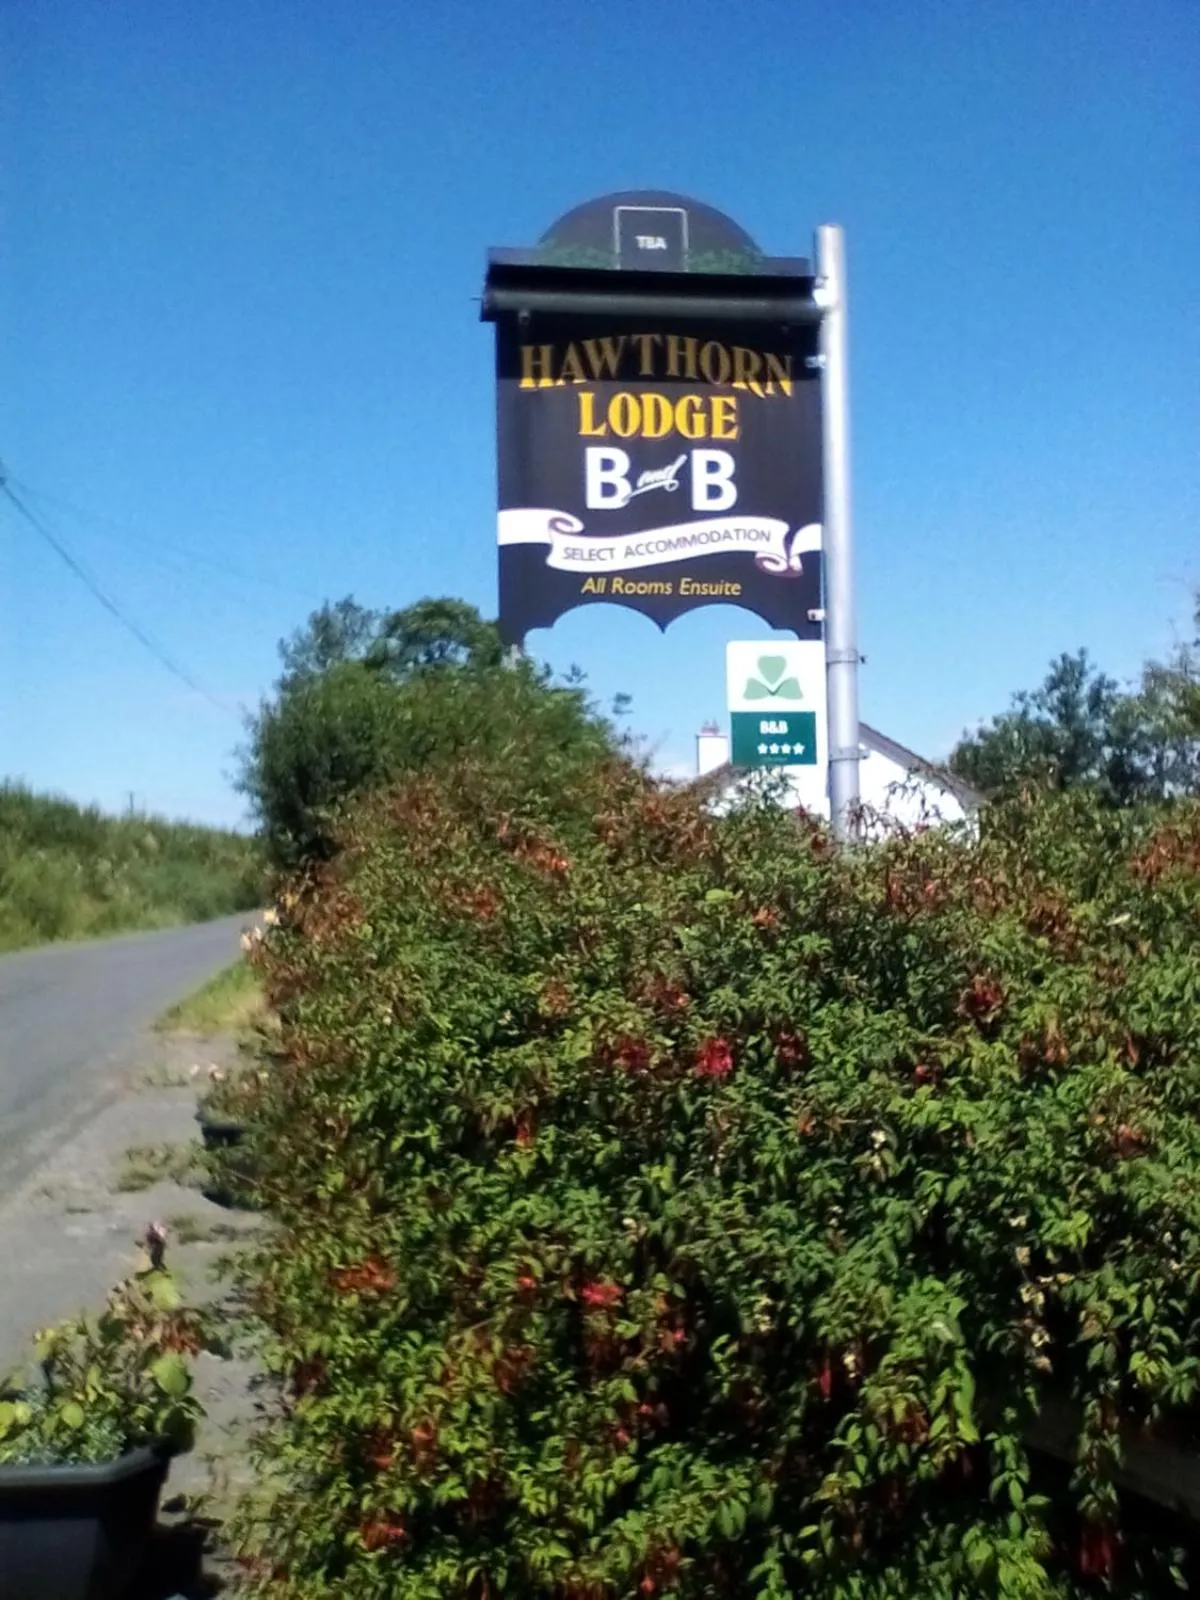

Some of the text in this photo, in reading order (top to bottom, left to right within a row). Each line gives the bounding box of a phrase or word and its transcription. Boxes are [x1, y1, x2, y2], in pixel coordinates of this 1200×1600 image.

[518, 334, 793, 399] HAWTHORN
[578, 391, 741, 440] LODGE
[584, 447, 738, 511] B and B
[563, 528, 772, 562] SELECT ACCOMMODATION
[580, 577, 742, 597] All Rooms Ensuite
[759, 720, 789, 735] B&B
